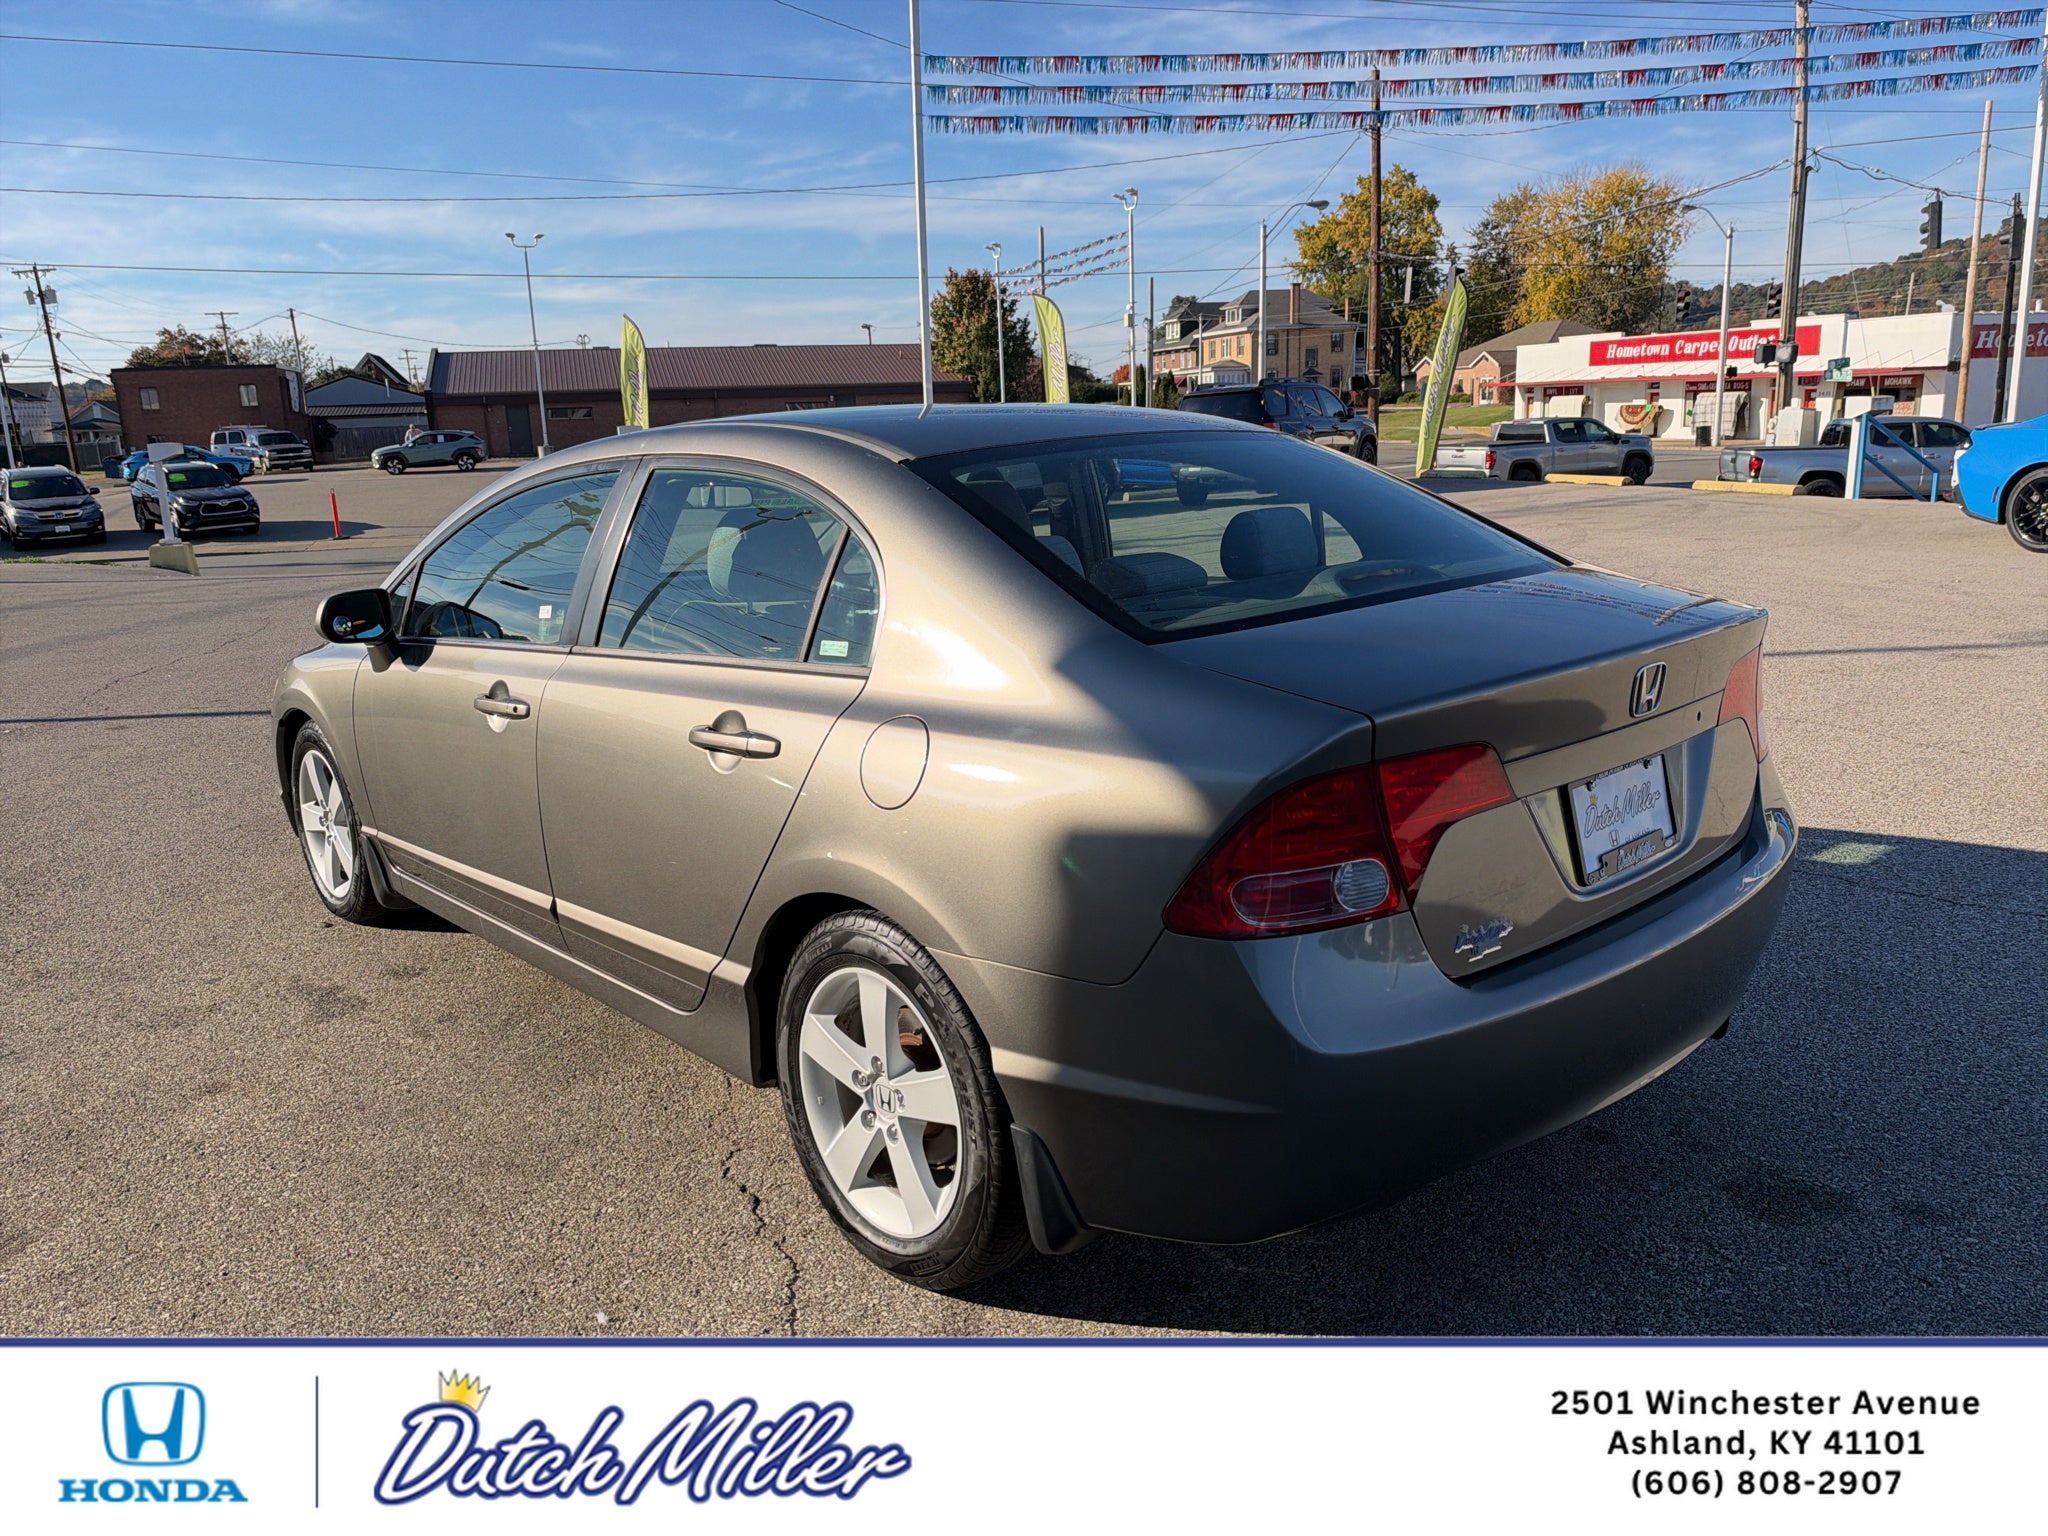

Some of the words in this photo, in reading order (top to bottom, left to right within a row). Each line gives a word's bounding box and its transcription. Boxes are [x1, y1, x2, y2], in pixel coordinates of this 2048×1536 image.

[1606, 343, 1669, 359] Hometown
[1674, 336, 1722, 356] Carpe
[1884, 376, 1913, 386] MOHAWK
[1584, 795, 1622, 839] Dutch
[1620, 781, 1661, 824] Miller
